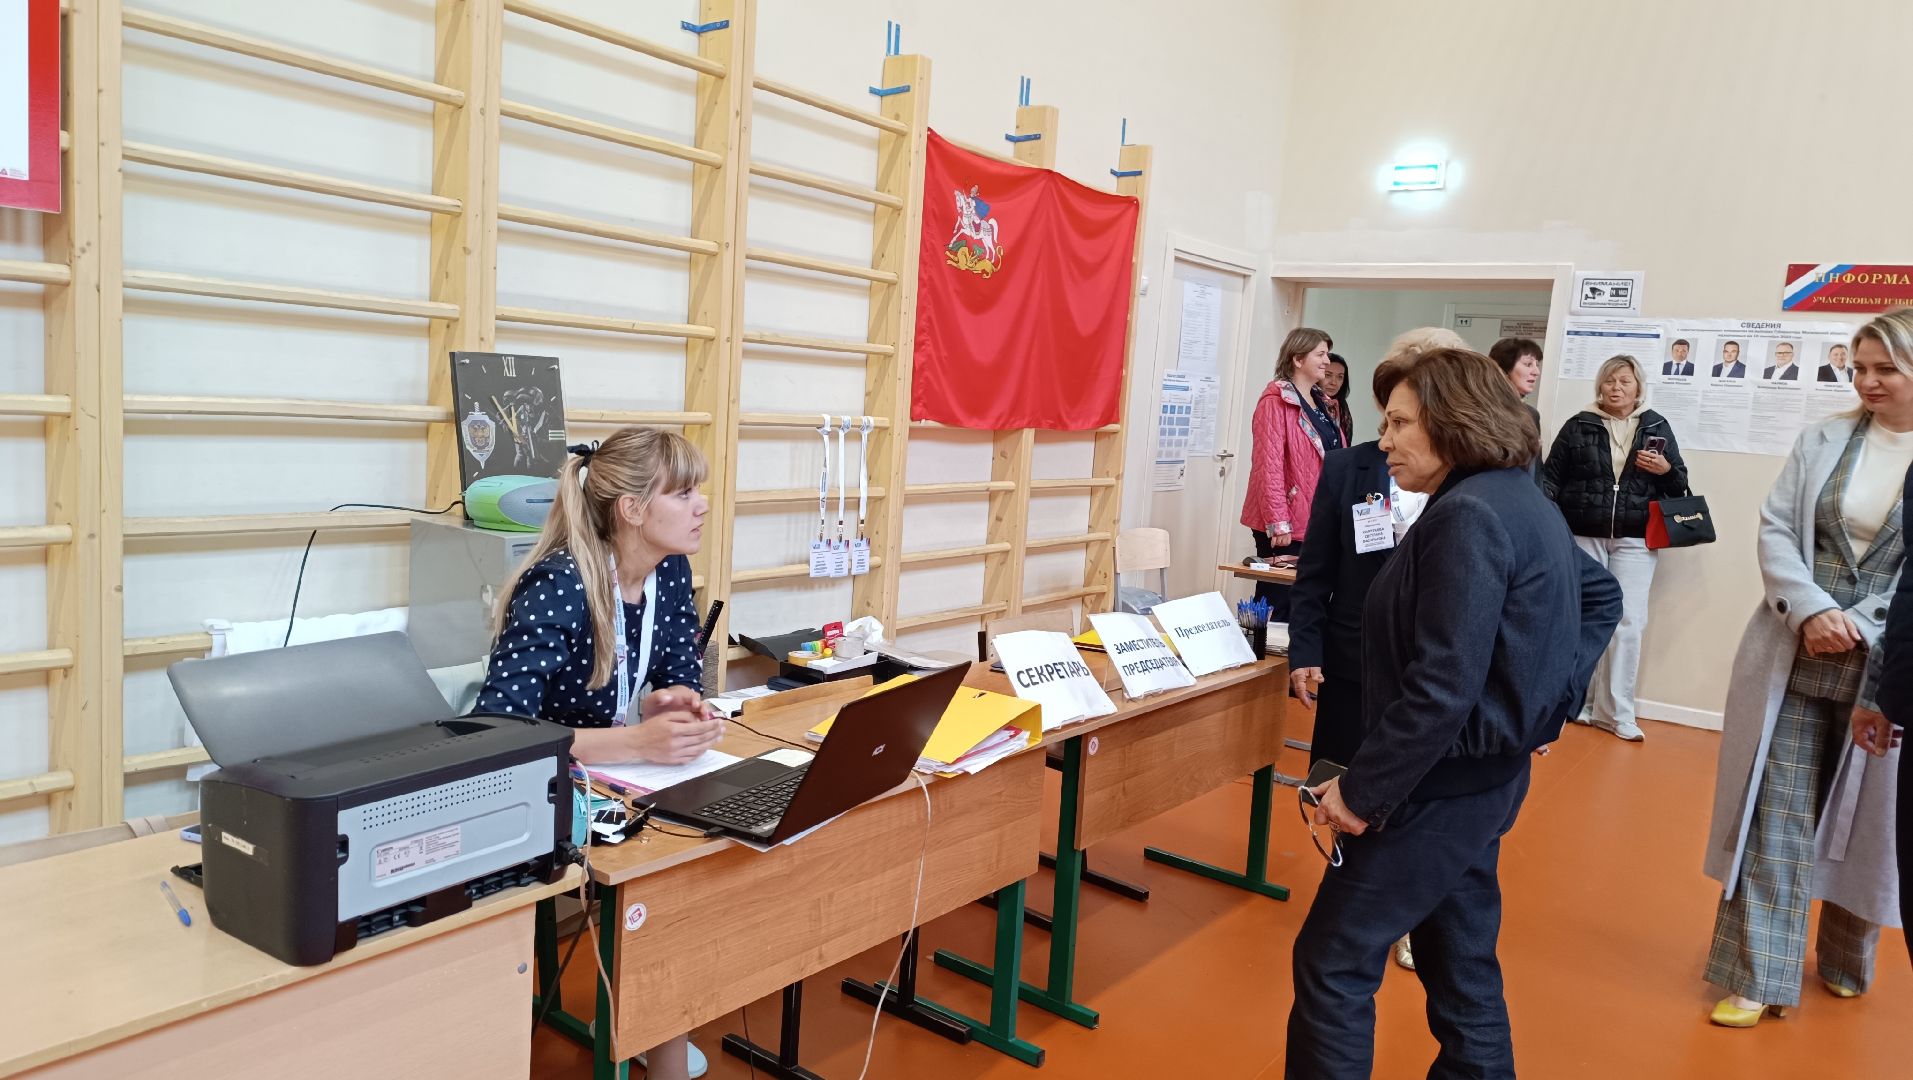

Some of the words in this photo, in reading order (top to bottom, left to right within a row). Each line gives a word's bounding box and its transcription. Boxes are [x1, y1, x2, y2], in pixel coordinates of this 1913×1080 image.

[1814, 272, 1911, 285] ИНФОРМА
[1812, 296, 1881, 305] УЧАСТКОВАЯ
[502, 356, 517, 377] XII
[1174, 619, 1231, 640] Председатель
[1113, 638, 1166, 655] ЗАМЕСТИТЕЛЬ
[1016, 660, 1090, 688] СЕКРЕТАРЬ
